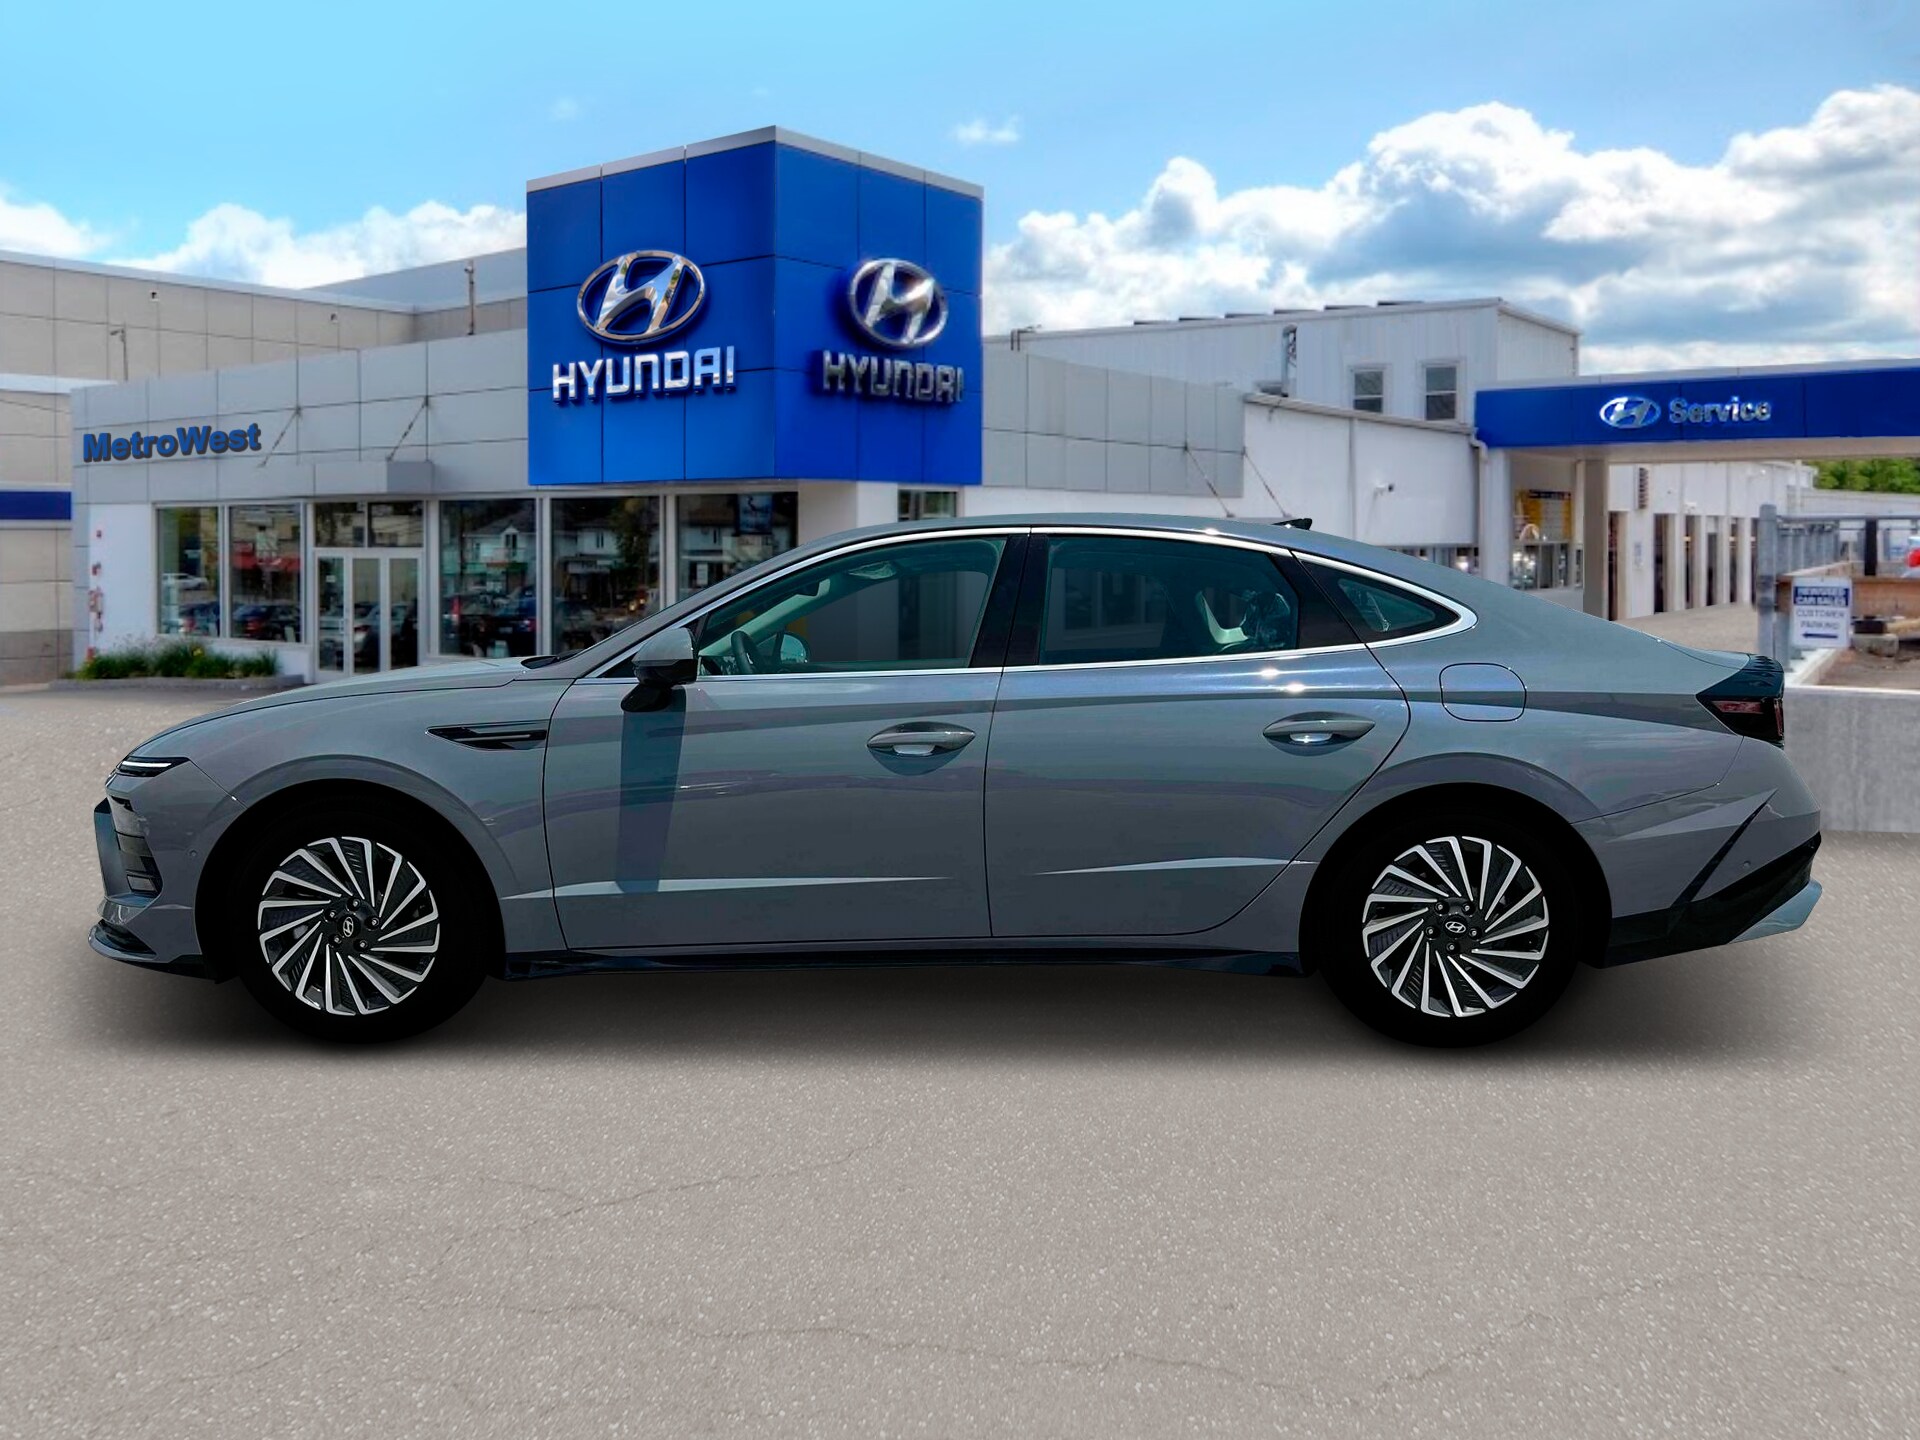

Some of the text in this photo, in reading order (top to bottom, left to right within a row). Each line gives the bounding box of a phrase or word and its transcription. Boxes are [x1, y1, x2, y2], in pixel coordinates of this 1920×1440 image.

[553, 346, 735, 400] HYUNDAI
[823, 350, 965, 403] HYUNDAI
[1669, 396, 1772, 423] Service
[83, 423, 262, 463] MetroWest
